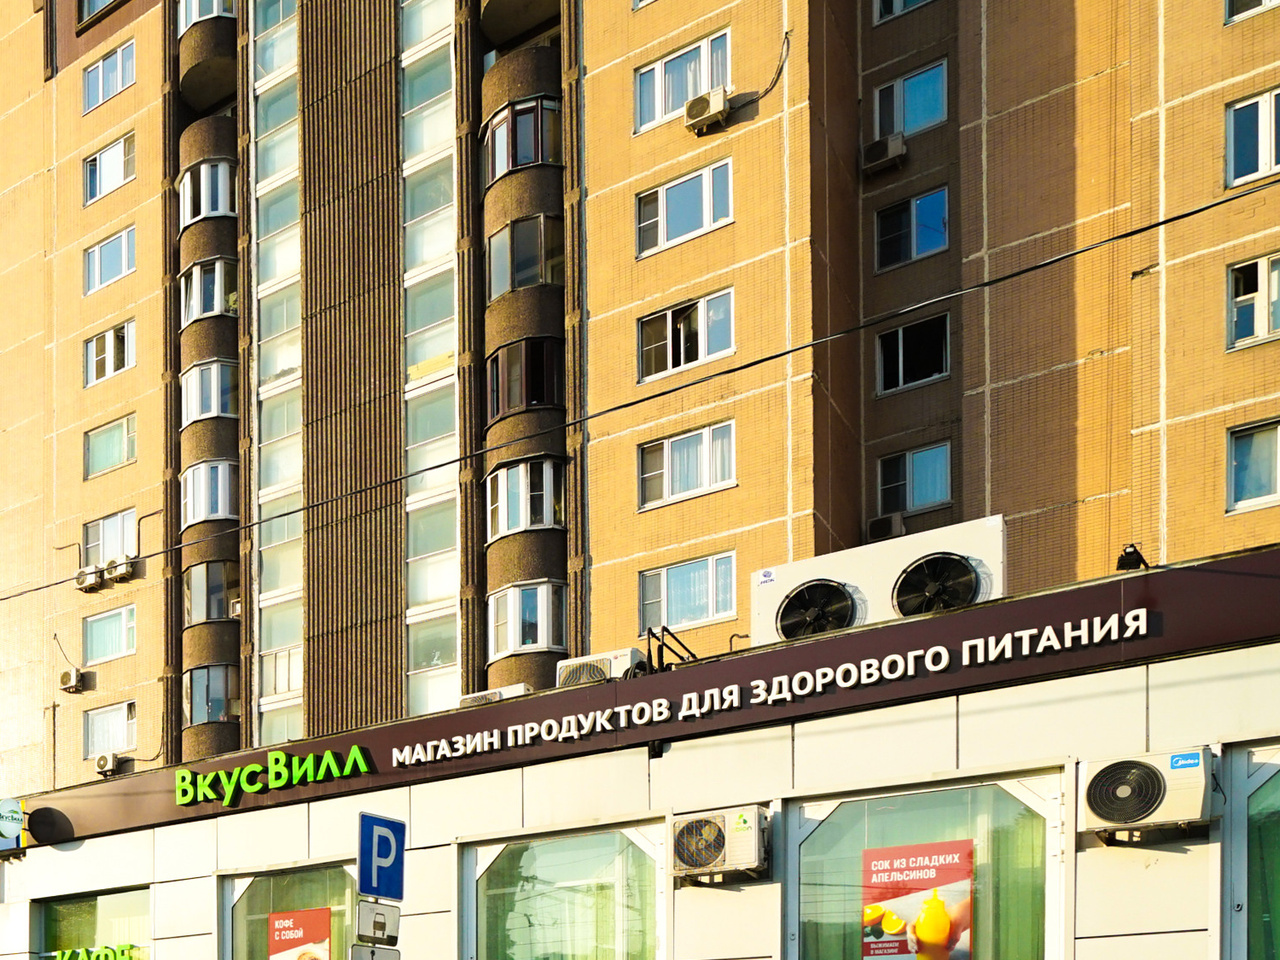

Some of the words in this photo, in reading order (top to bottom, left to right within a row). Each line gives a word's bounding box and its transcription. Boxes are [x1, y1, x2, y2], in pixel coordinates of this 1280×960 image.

[392, 728, 501, 768] МАГАЗИН
[507, 698, 671, 748] ПРОДУКТОВ
[678, 684, 742, 721] ДЛЯ
[749, 644, 951, 705] ЗДОРОВОГО
[962, 607, 1149, 667] ПИТАНИЯ
[175, 744, 370, 807] ВкусВилл
[371, 825, 397, 888] P
[871, 860, 891, 871] СОК
[893, 858, 906, 869] ИЗ
[909, 853, 960, 868] СЛАДКИХ
[871, 868, 937, 883] АПЕЛЬСИНОВ
[274, 919, 294, 929] КОФЕ
[274, 932, 280, 940] С
[281, 928, 304, 939] СОБОЙ
